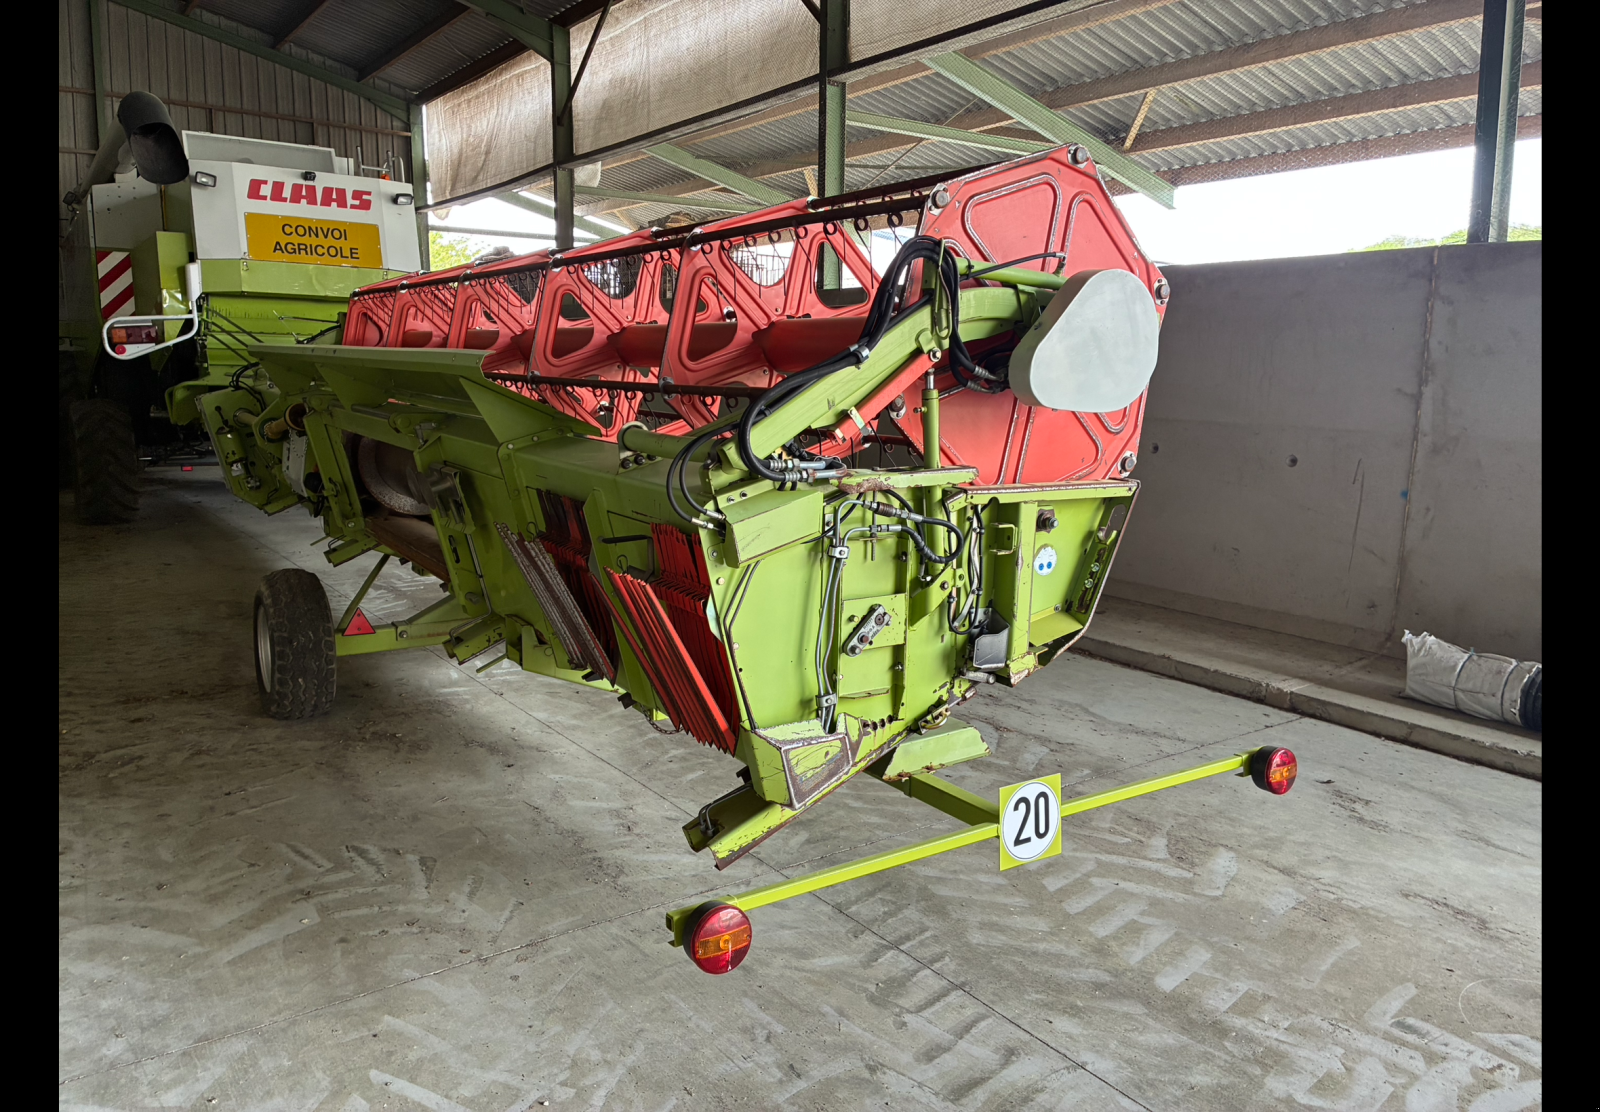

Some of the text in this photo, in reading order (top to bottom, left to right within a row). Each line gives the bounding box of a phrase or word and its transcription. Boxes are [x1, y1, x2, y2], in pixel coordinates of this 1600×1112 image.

[247, 179, 372, 211] CLAAS
[281, 223, 348, 241] CONVOI
[273, 241, 360, 260] AGRICOLE
[1013, 791, 1050, 847] 20
